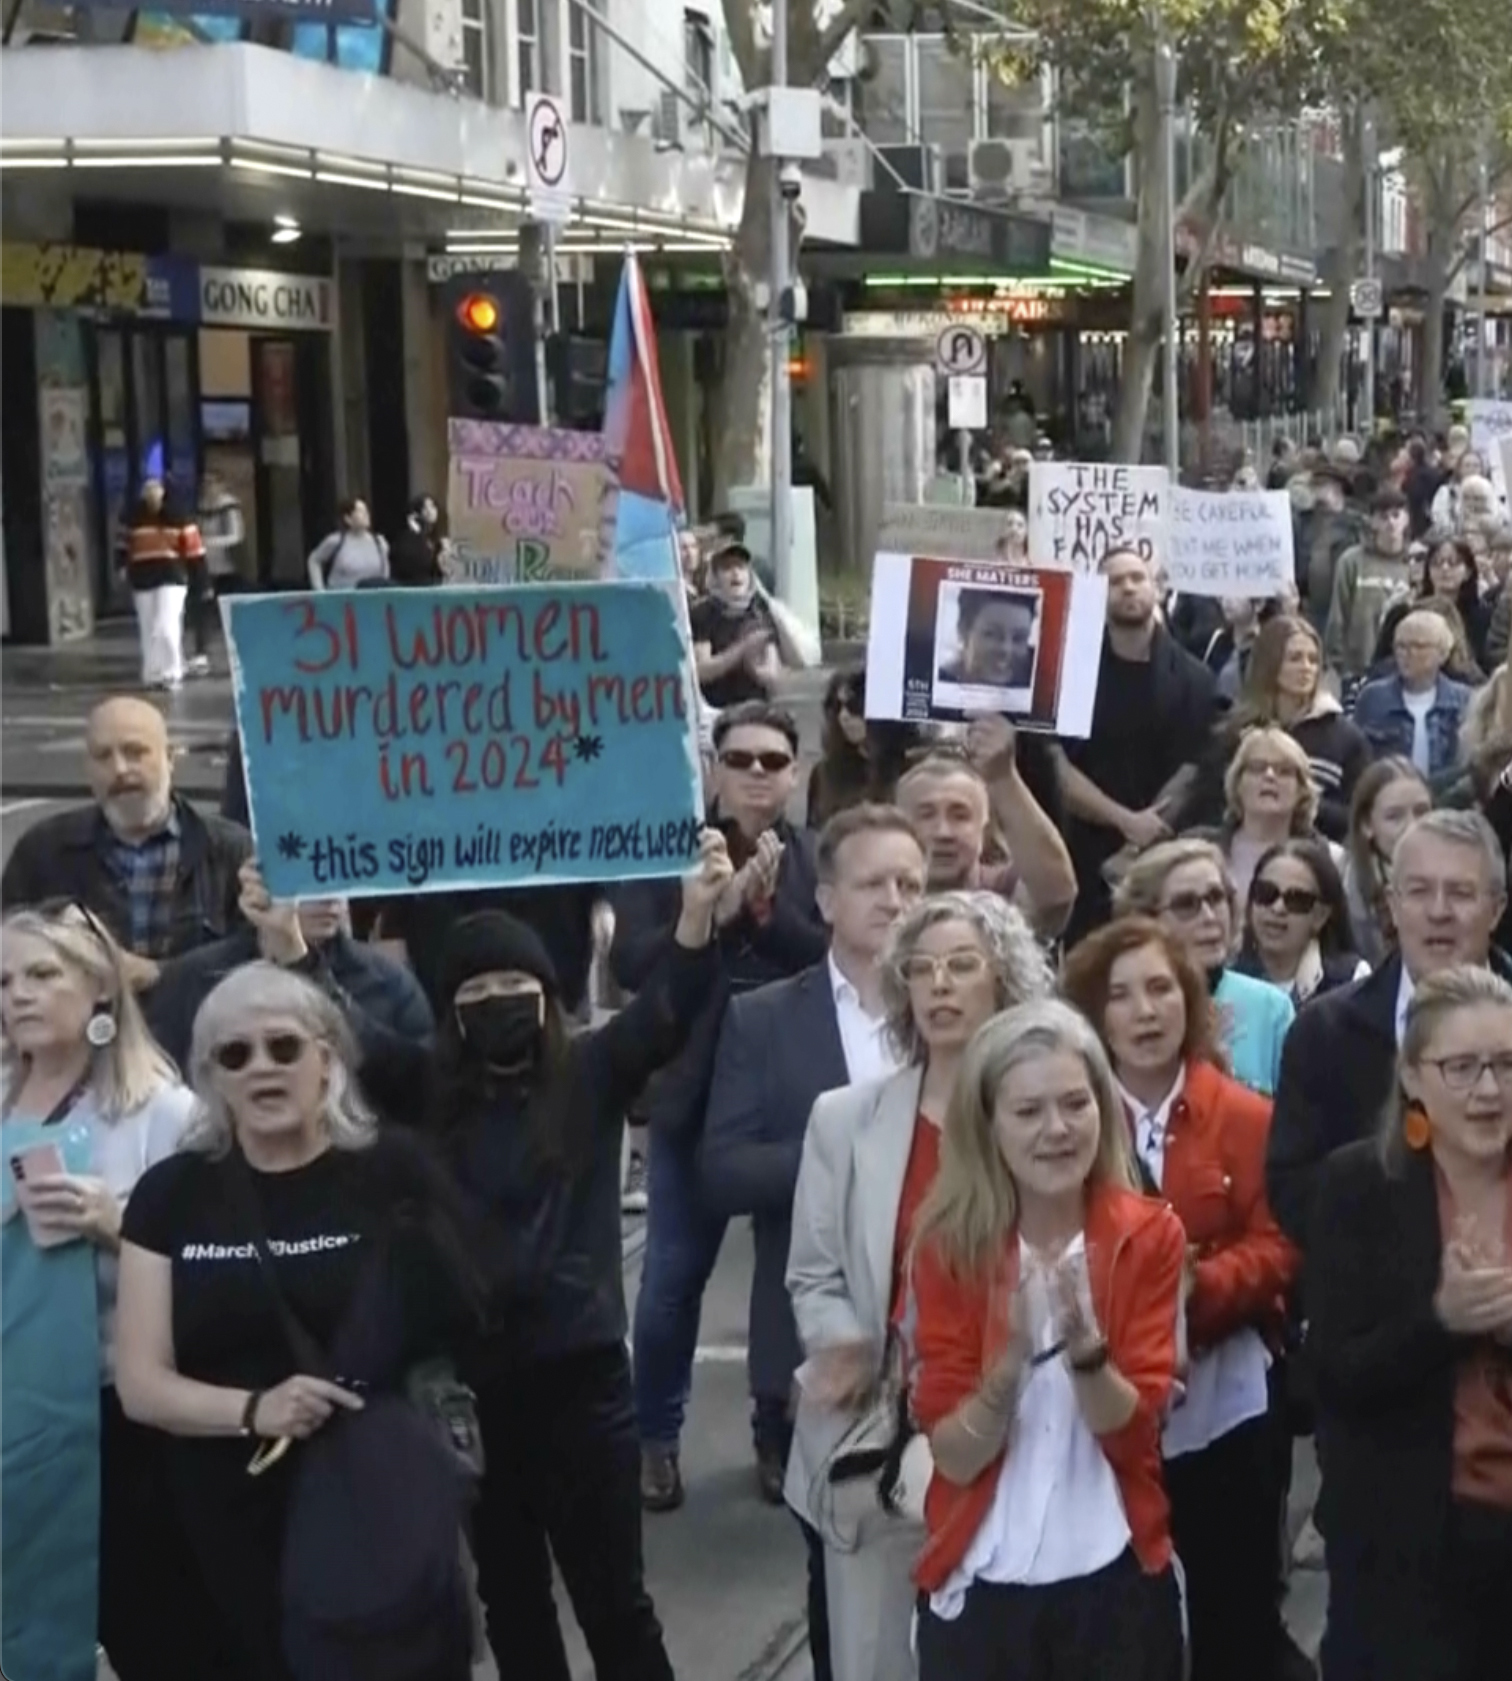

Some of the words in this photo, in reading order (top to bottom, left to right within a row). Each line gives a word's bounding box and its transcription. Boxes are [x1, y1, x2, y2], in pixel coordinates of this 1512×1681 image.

[203, 279, 270, 317] GONG
[273, 286, 317, 321] CHA
[458, 460, 575, 510] Teach
[1066, 465, 1128, 491] THE
[1048, 487, 1158, 518] SYSTEM
[1076, 514, 1124, 541] HAS
[1233, 535, 1282, 557] WHEN
[947, 566, 971, 582] SHE
[975, 568, 1041, 588] MATTERS
[284, 598, 358, 673] 31
[259, 670, 513, 744] murdered
[532, 670, 579, 741] by
[587, 670, 687, 727] men
[379, 741, 435, 803] in
[388, 828, 446, 885] sign
[454, 820, 502, 870] will
[509, 821, 582, 872] expire
[589, 816, 643, 862] next
[646, 815, 705, 862] week
